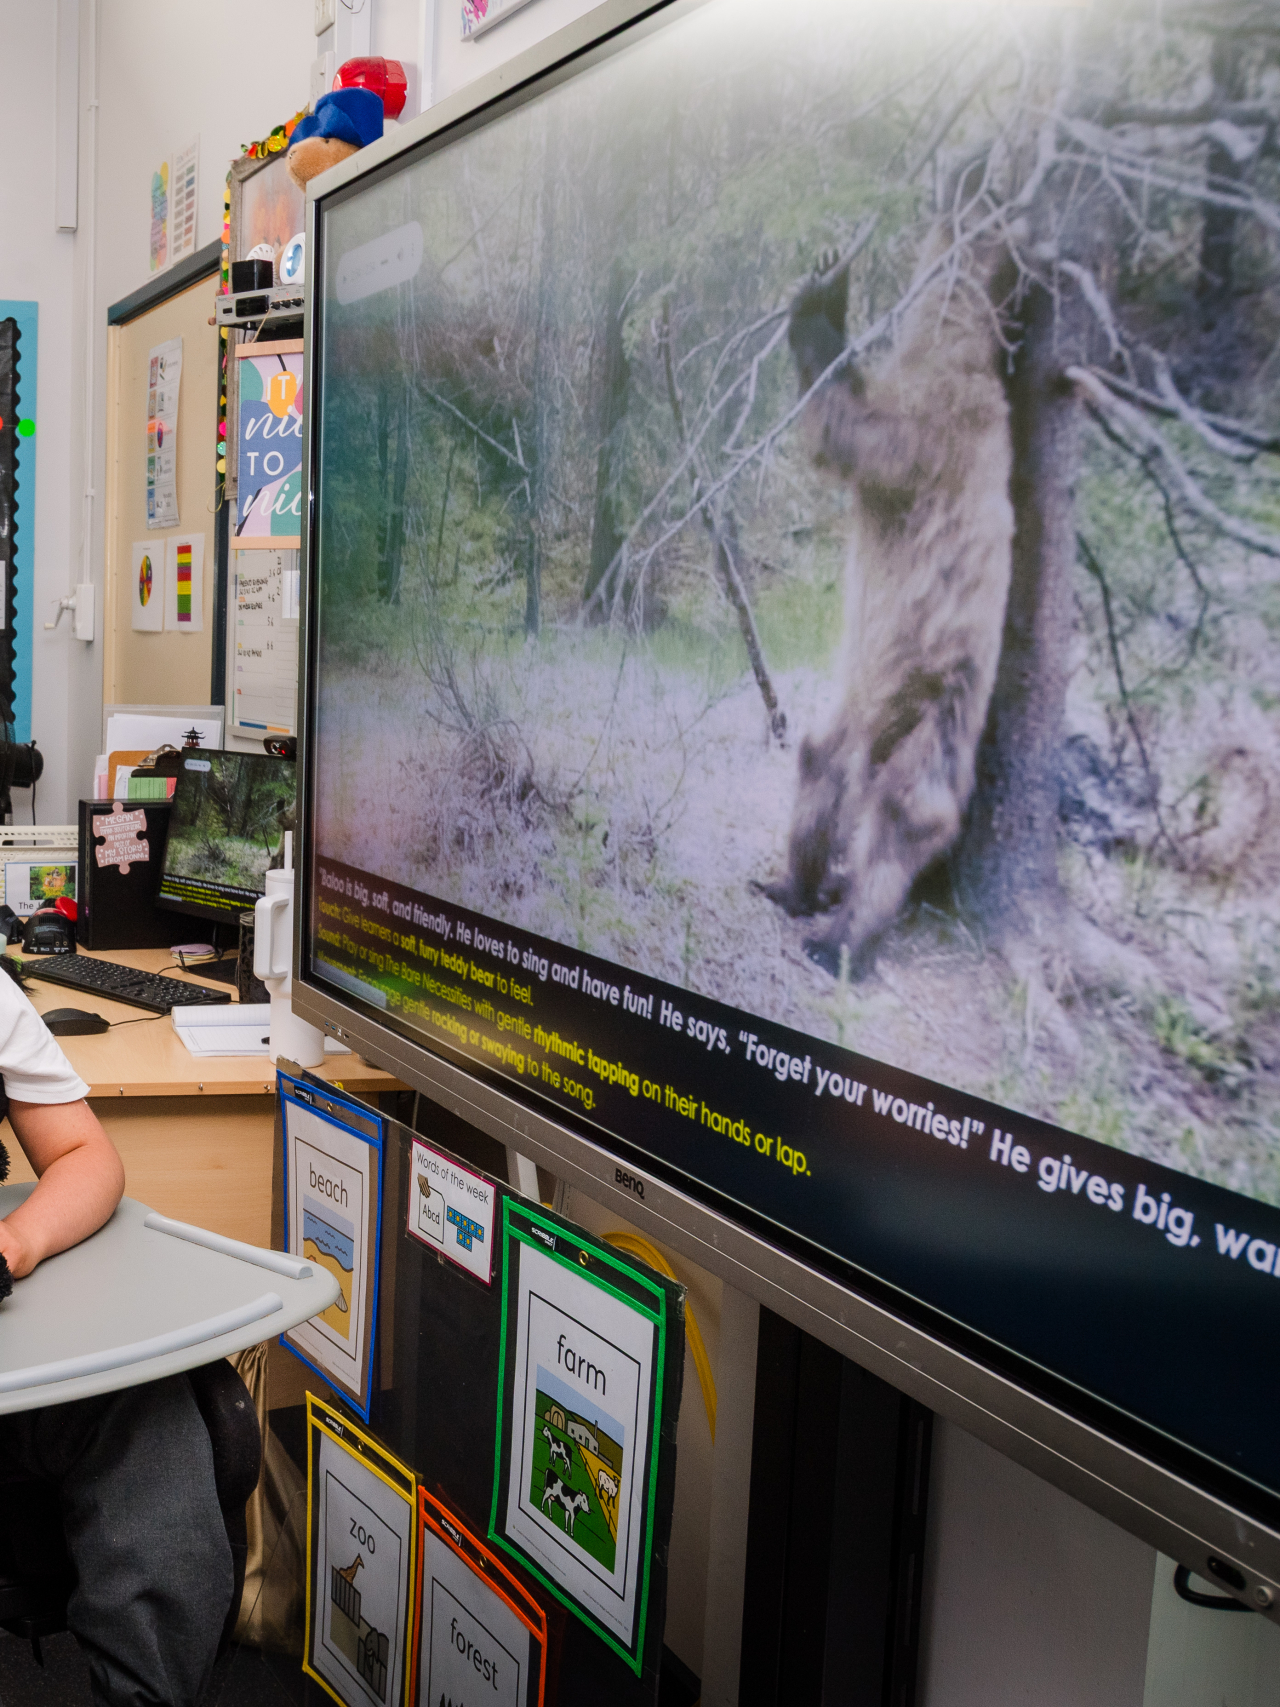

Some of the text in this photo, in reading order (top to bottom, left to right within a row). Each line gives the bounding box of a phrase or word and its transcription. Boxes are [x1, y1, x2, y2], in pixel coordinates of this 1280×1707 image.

[266, 374, 302, 401] IT'
[246, 450, 285, 476] TO
[105, 813, 134, 825] MEGAN
[105, 844, 143, 858] MY STORY
[105, 855, 124, 865] FROM
[18, 902, 34, 910] The
[392, 931, 400, 946] a
[441, 947, 469, 980] teddy
[470, 960, 495, 988] bear
[496, 971, 508, 994] to
[509, 977, 534, 1007] feel.
[345, 877, 352, 897] is
[353, 881, 370, 907] big,
[372, 891, 390, 914] soft,
[392, 900, 412, 921] and
[413, 903, 453, 941] friendly.
[456, 920, 471, 945] He
[473, 927, 504, 959] loves
[506, 940, 520, 965] to
[522, 947, 549, 982] sing
[551, 963, 580, 989] and
[582, 969, 620, 1006] have
[622, 984, 654, 1020] fun!
[660, 999, 683, 1032] He
[686, 1016, 732, 1055] says,
[815, 1065, 867, 1106] your
[989, 1128, 1031, 1173] He
[1037, 1154, 1125, 1212] gives
[1132, 1184, 1201, 1248] big,
[401, 961, 421, 986] Bare
[422, 972, 472, 1011] Necessities
[473, 998, 495, 1022] with
[496, 1010, 532, 1040] gentle
[533, 1024, 585, 1066] rhythmic
[587, 1048, 639, 1097] tapping
[642, 1079, 661, 1103] on
[664, 1085, 699, 1121] their
[700, 1100, 751, 1147] hands
[754, 1133, 774, 1157] or
[776, 1136, 811, 1177] lap.
[431, 1009, 468, 1044] rocking
[469, 1029, 480, 1047] or
[481, 1035, 525, 1074] swaying
[527, 1053, 539, 1077] to
[541, 1060, 561, 1089] the
[563, 1076, 597, 1110] song.
[308, 1161, 349, 1208] beach
[416, 1150, 489, 1205] Words of the week
[422, 1203, 440, 1225] Abcd
[556, 1333, 607, 1396] farm
[349, 1516, 376, 1555] zoo
[450, 1617, 499, 1691] forest
